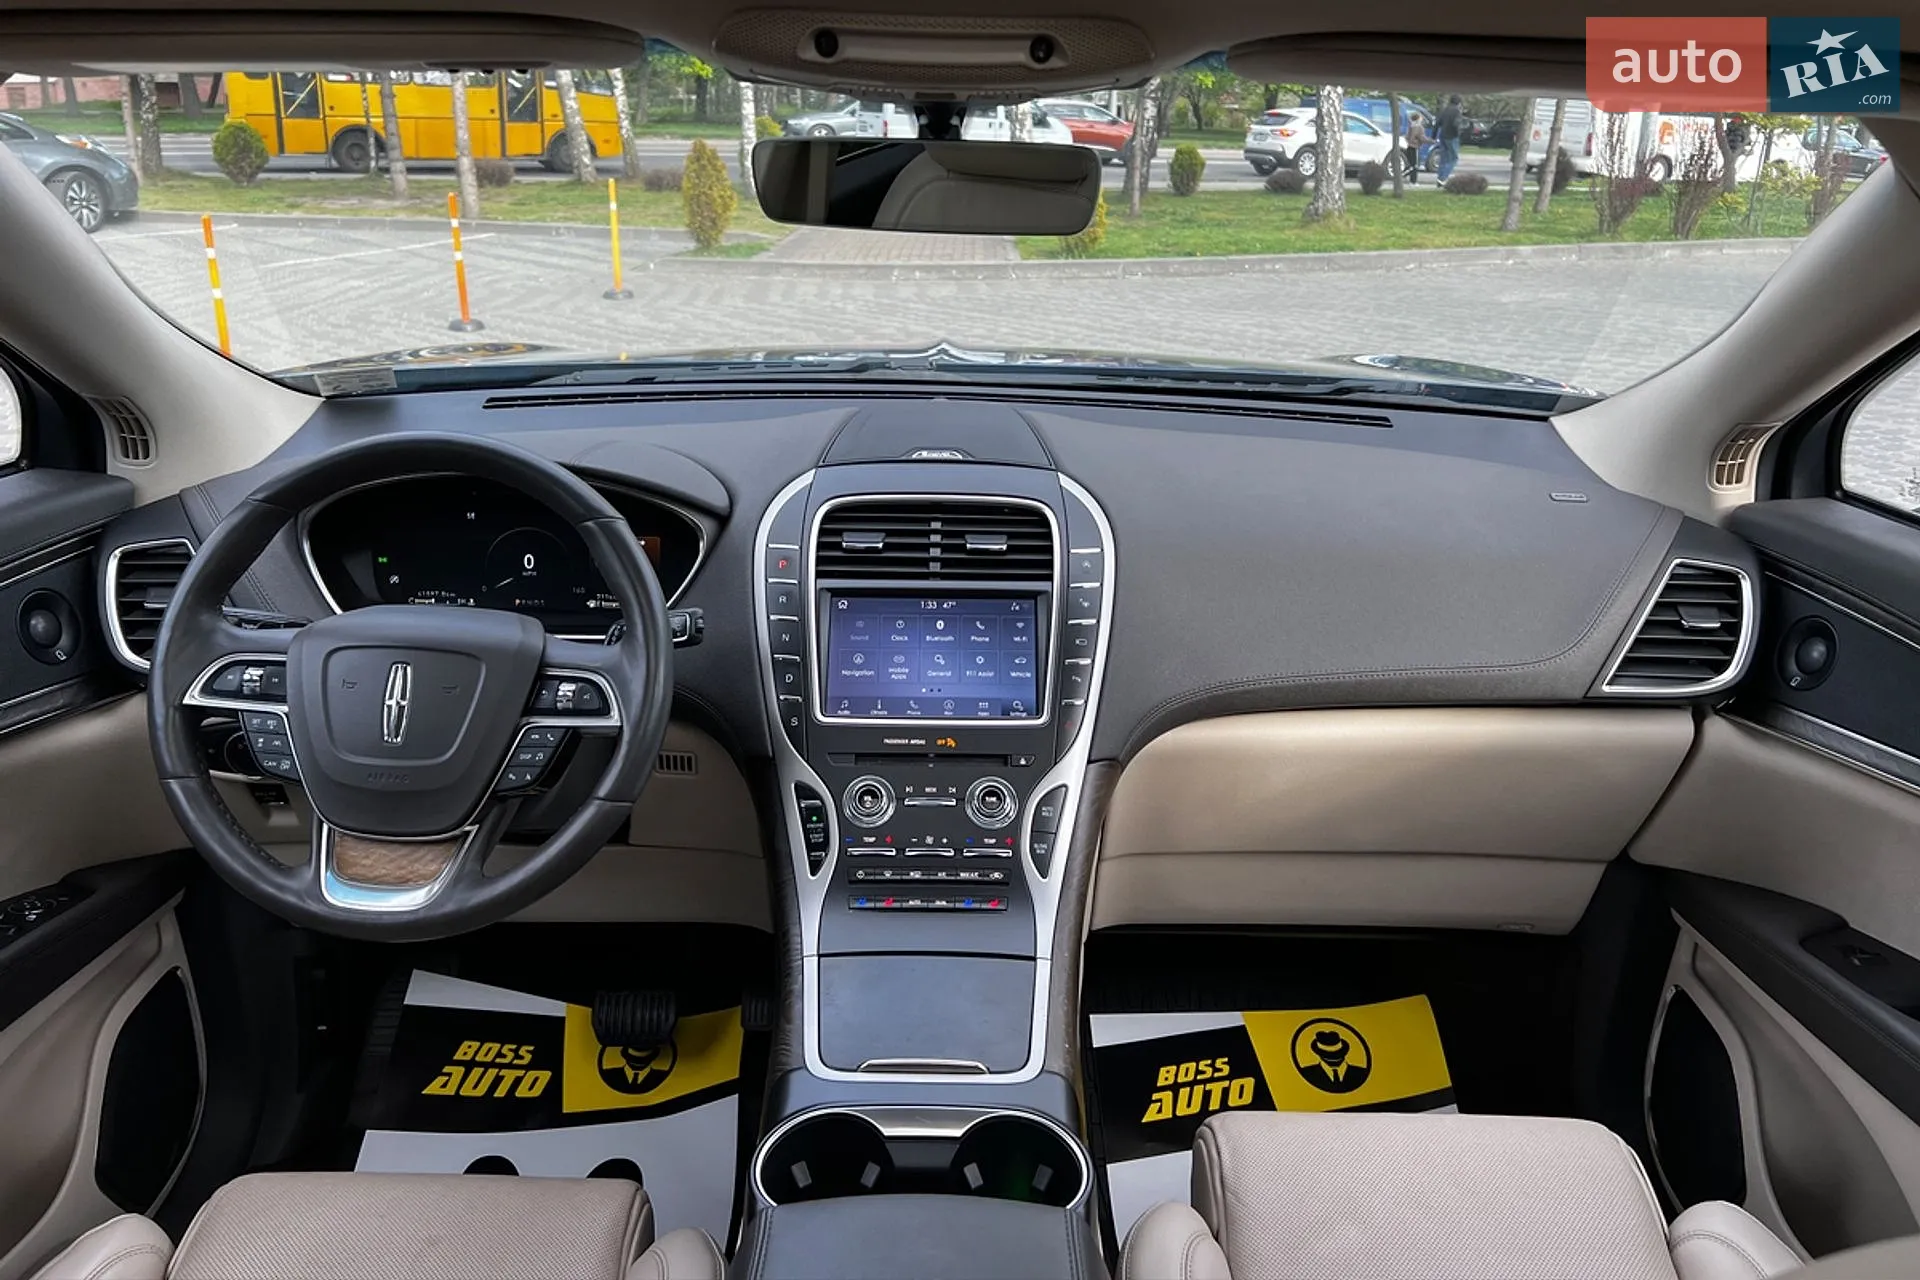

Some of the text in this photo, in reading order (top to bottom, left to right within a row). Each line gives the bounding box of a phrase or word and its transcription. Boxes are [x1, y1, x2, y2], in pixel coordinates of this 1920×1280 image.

[523, 553, 535, 570] 0
[778, 560, 788, 570] P
[779, 595, 787, 604] R
[920, 601, 937, 609] 1:33
[782, 633, 790, 642] N
[970, 635, 990, 643] Phone
[785, 673, 794, 683] D
[841, 669, 875, 677] Navigation
[790, 717, 799, 726] S
[452, 1040, 535, 1065] BOSS
[1156, 1057, 1230, 1087] BOSS
[421, 1065, 552, 1098] AUTO
[1141, 1076, 1255, 1123] AUTO
